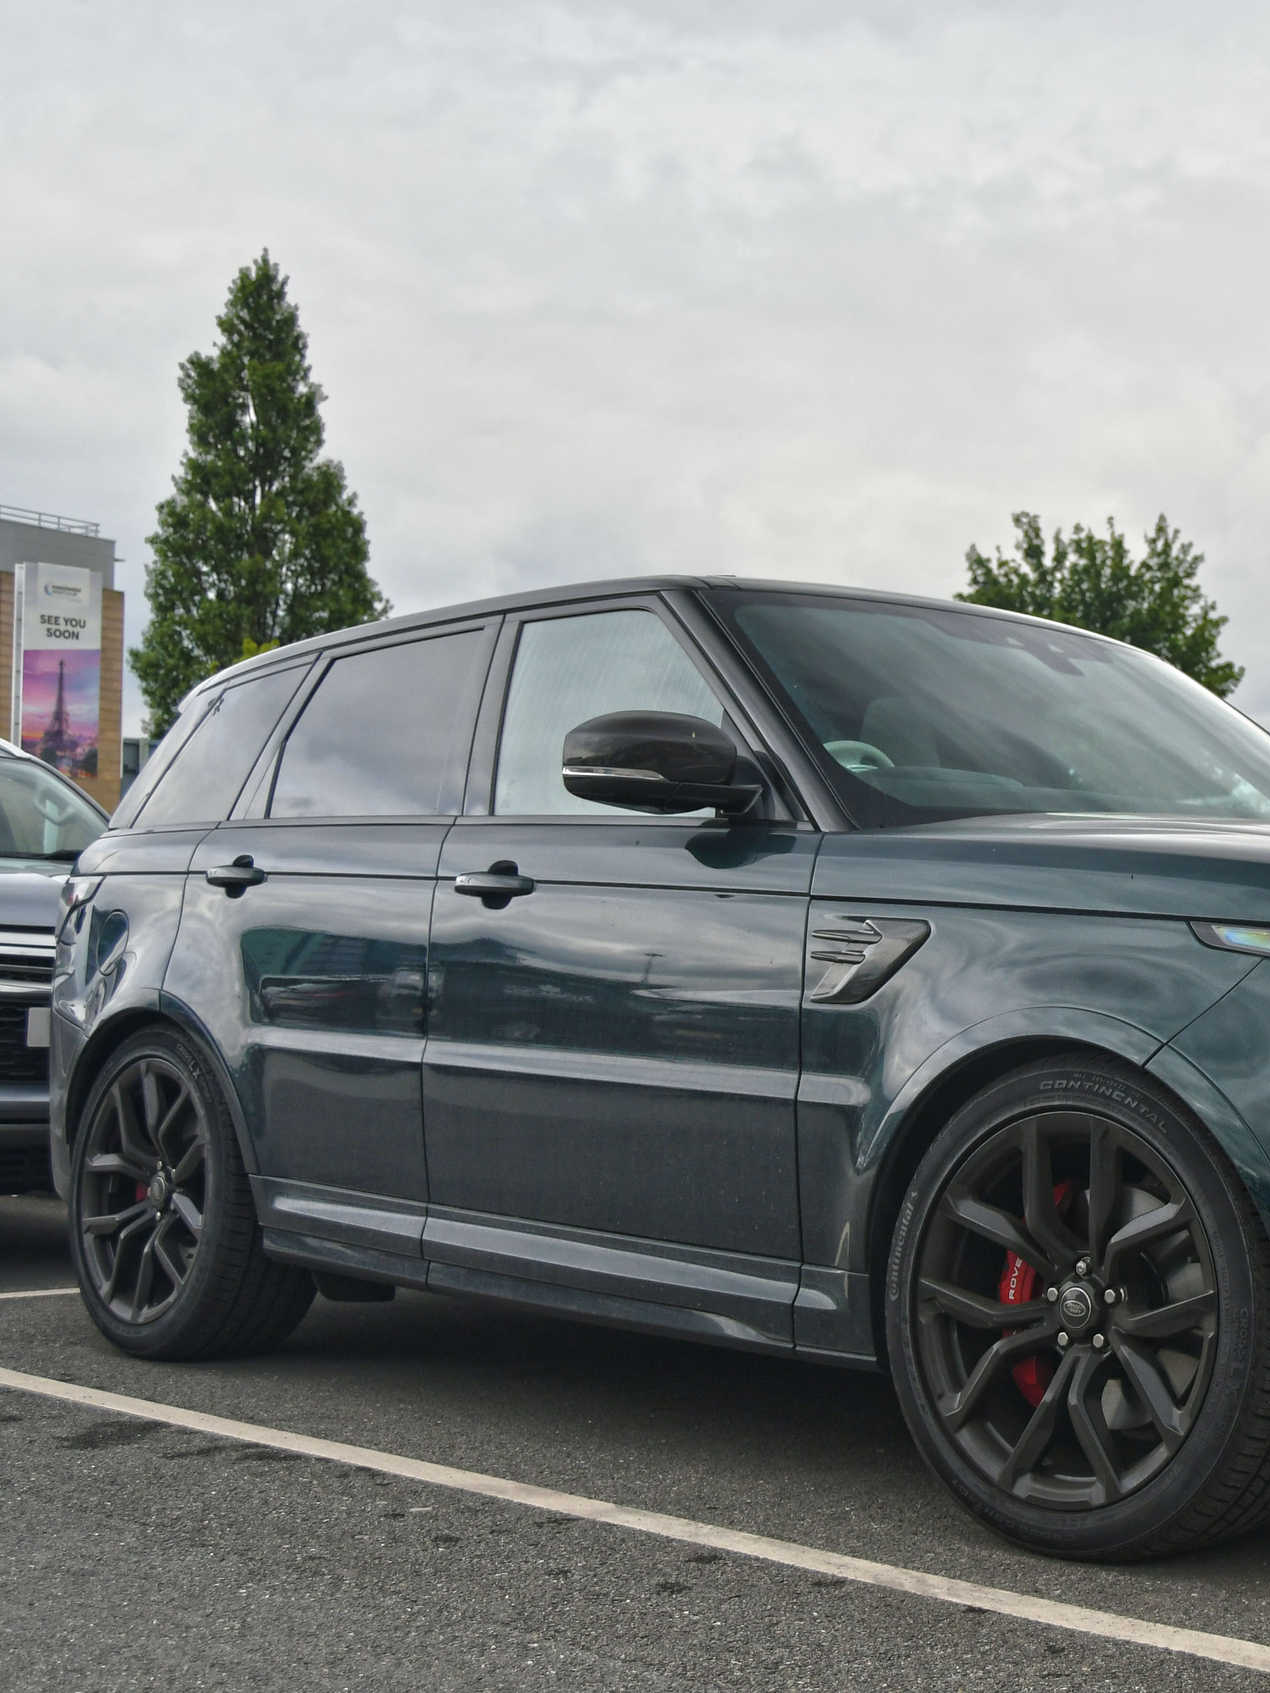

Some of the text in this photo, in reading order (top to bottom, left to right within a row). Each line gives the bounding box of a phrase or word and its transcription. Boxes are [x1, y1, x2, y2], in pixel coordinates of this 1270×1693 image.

[40, 614, 86, 629] SEE YOU
[46, 628, 80, 640] SOON
[1039, 1079, 1169, 1134] CONTINENTAL
[889, 1202, 915, 1302] Continental
[1237, 1308, 1249, 1361] CROSS
